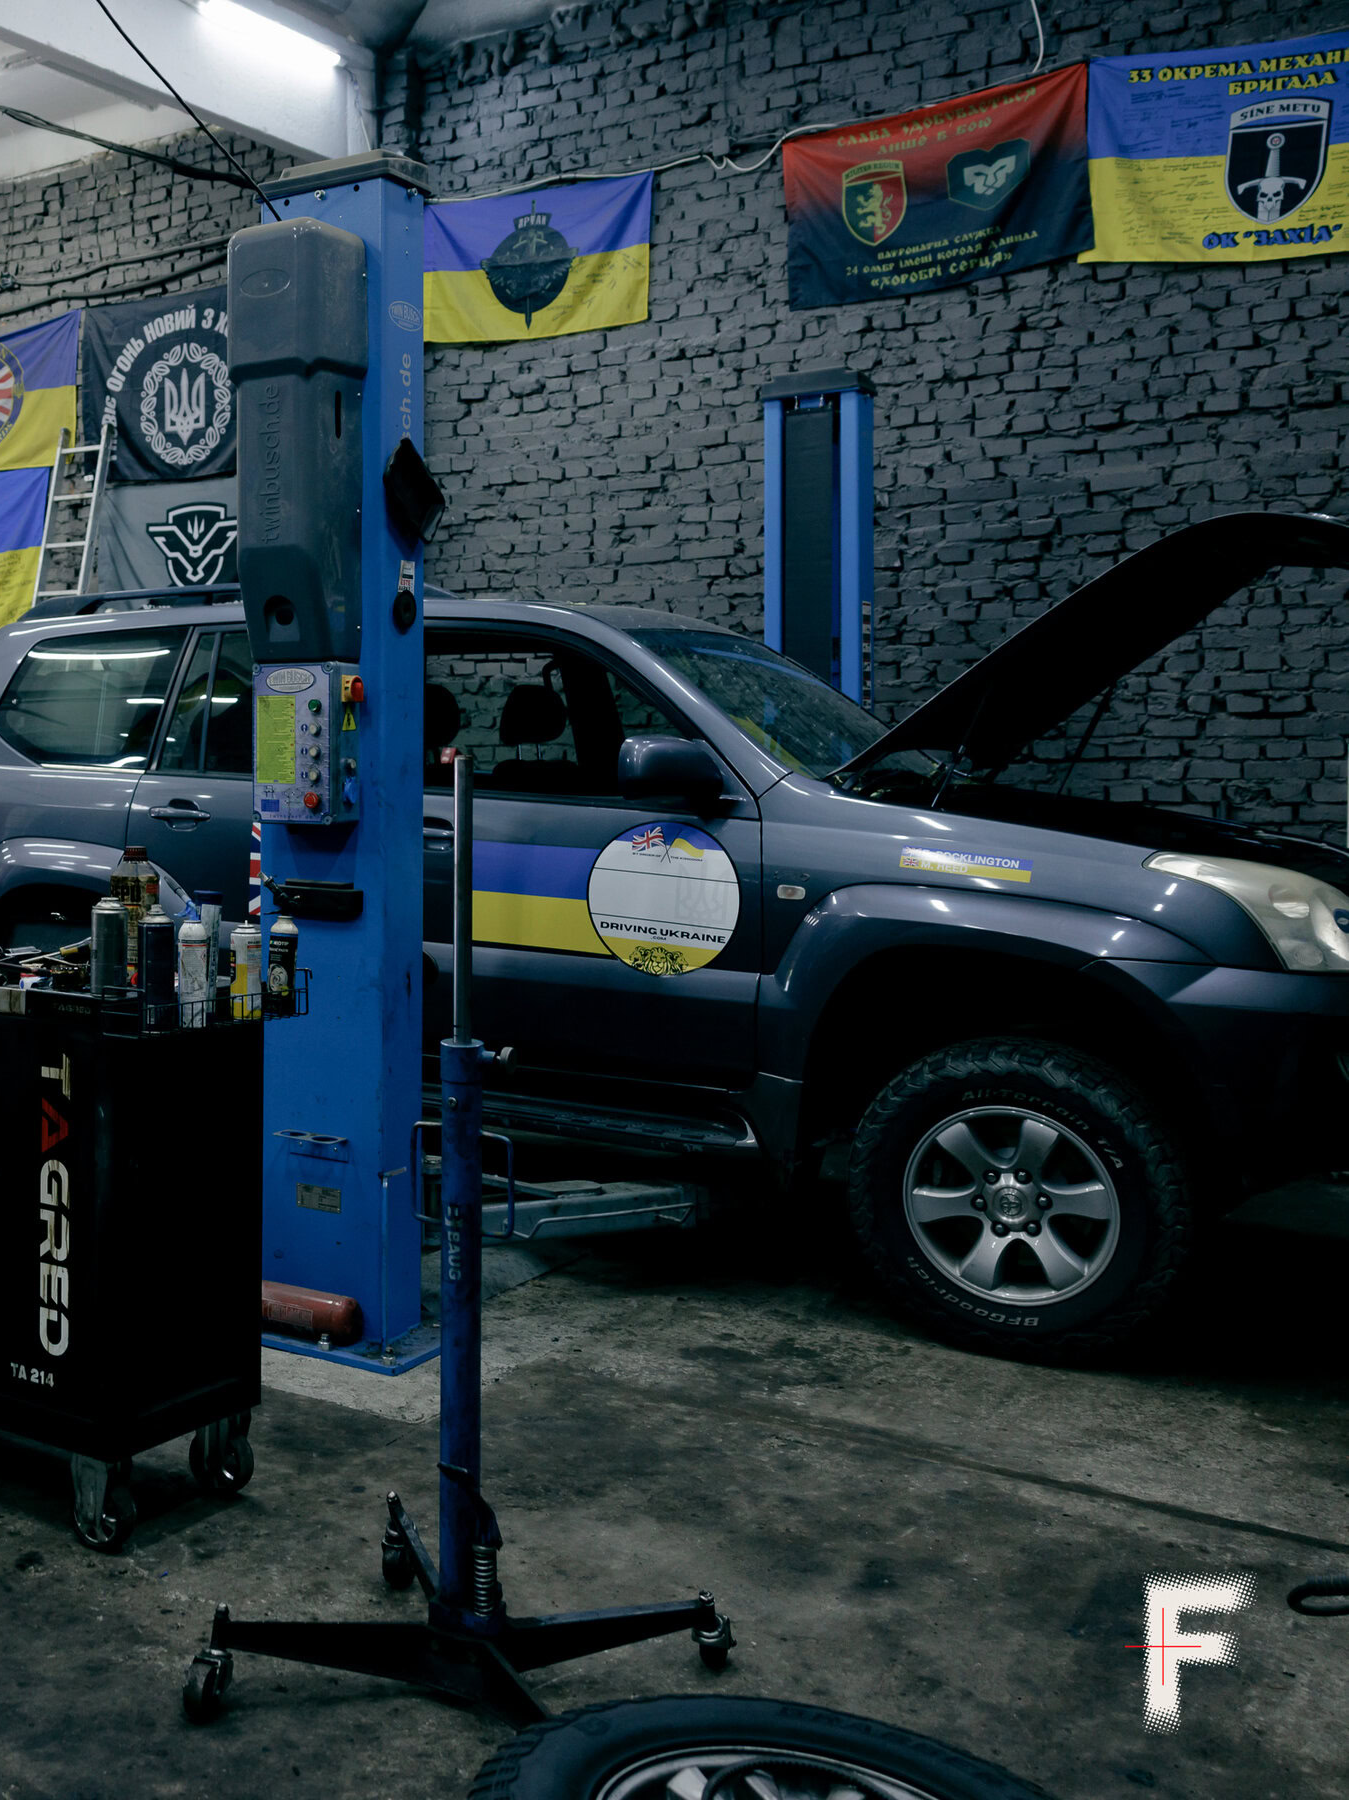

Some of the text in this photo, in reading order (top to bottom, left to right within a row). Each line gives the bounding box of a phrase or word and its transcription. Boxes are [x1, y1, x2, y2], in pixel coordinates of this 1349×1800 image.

[1128, 68, 1153, 83] 33
[1158, 60, 1254, 82] ОКРЕМА
[1228, 70, 1337, 96] БРИГАДА
[837, 127, 891, 148] СЛАВА
[1202, 231, 1238, 249] ОК
[846, 265, 859, 276] 24
[106, 337, 146, 393] ОГОНЬ
[143, 303, 197, 344] НОВИЙ
[259, 383, 281, 545] twinbusch.de
[920, 861, 968, 874] M. REED
[600, 921, 726, 944] DRIVING UKRAINE
[39, 1053, 71, 1357] TAGRED
[447, 1231, 462, 1281] BAUG
[907, 1257, 1040, 1327] BFGoodrich
[10, 1361, 55, 1388] TA 214
